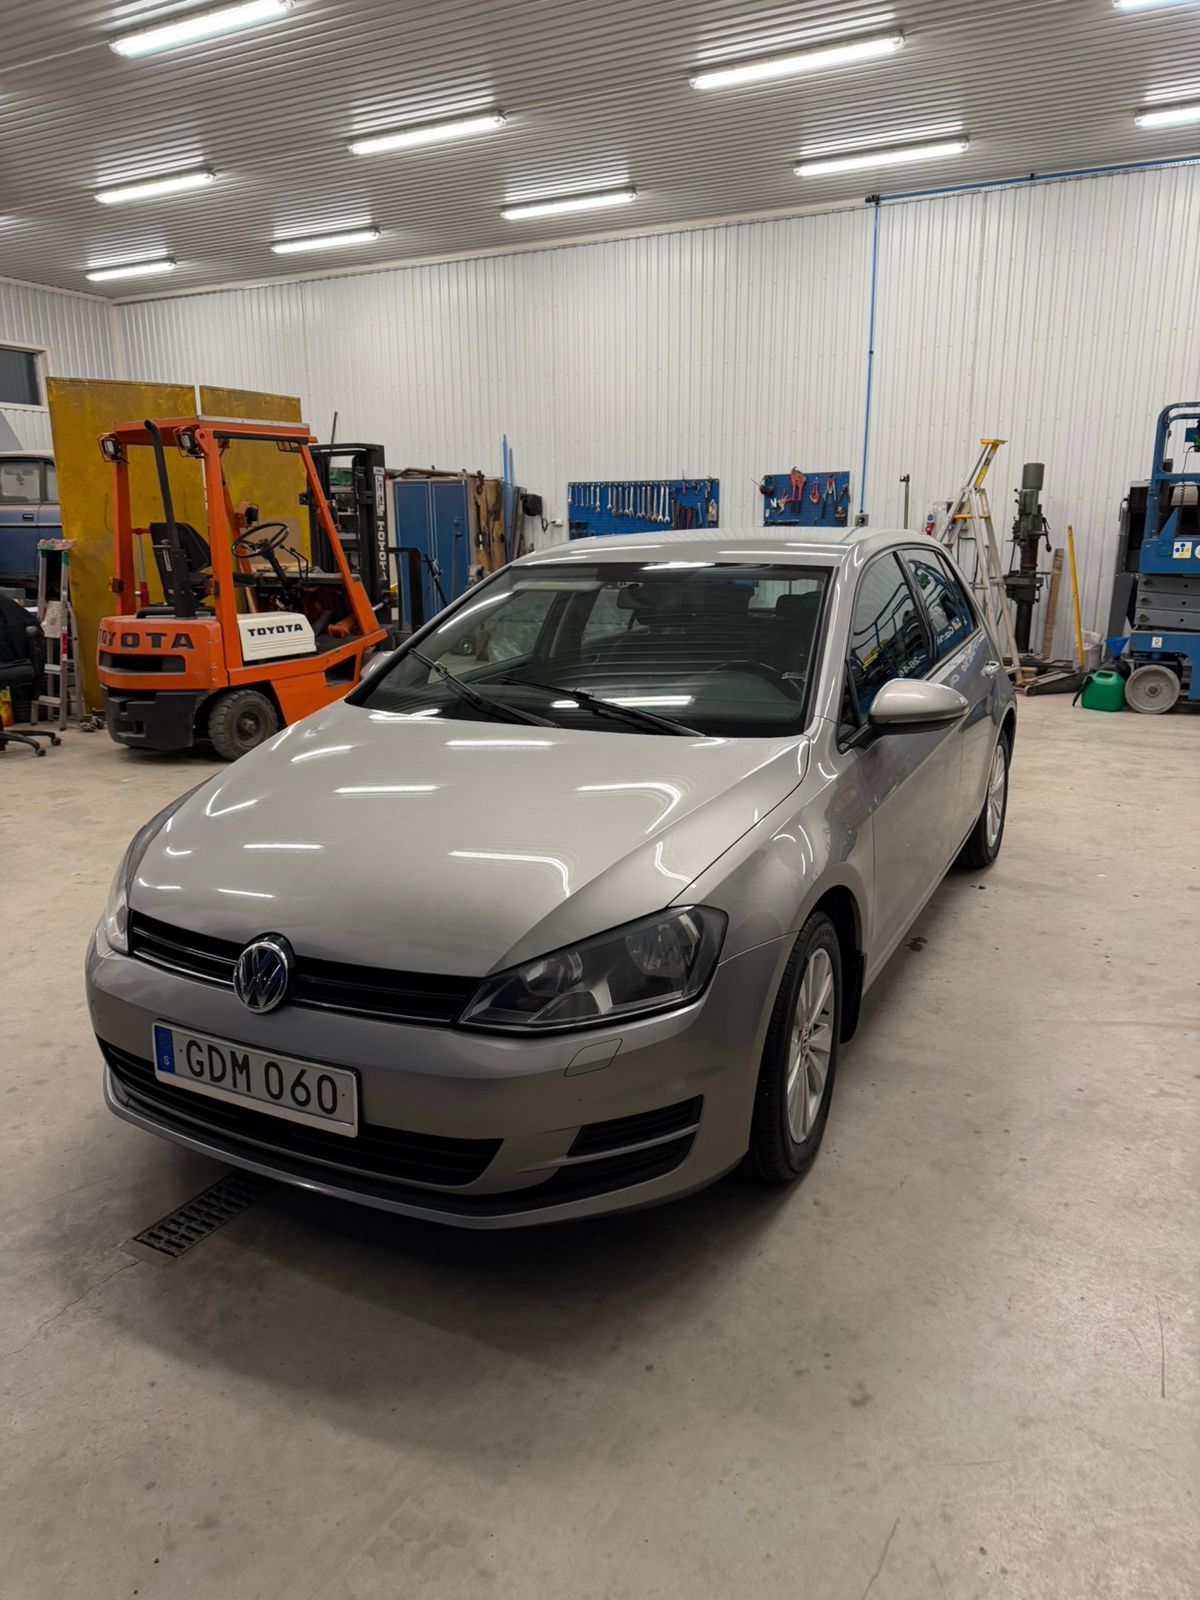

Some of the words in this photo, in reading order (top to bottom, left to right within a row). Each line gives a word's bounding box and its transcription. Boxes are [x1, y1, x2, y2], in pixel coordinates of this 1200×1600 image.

[377, 520, 388, 581] TOYOTA
[97, 628, 195, 650] TOYOTA
[247, 623, 304, 637] TOYOTA
[163, 1055, 170, 1066] S
[186, 1039, 252, 1093] GDM
[264, 1061, 338, 1115] 060
